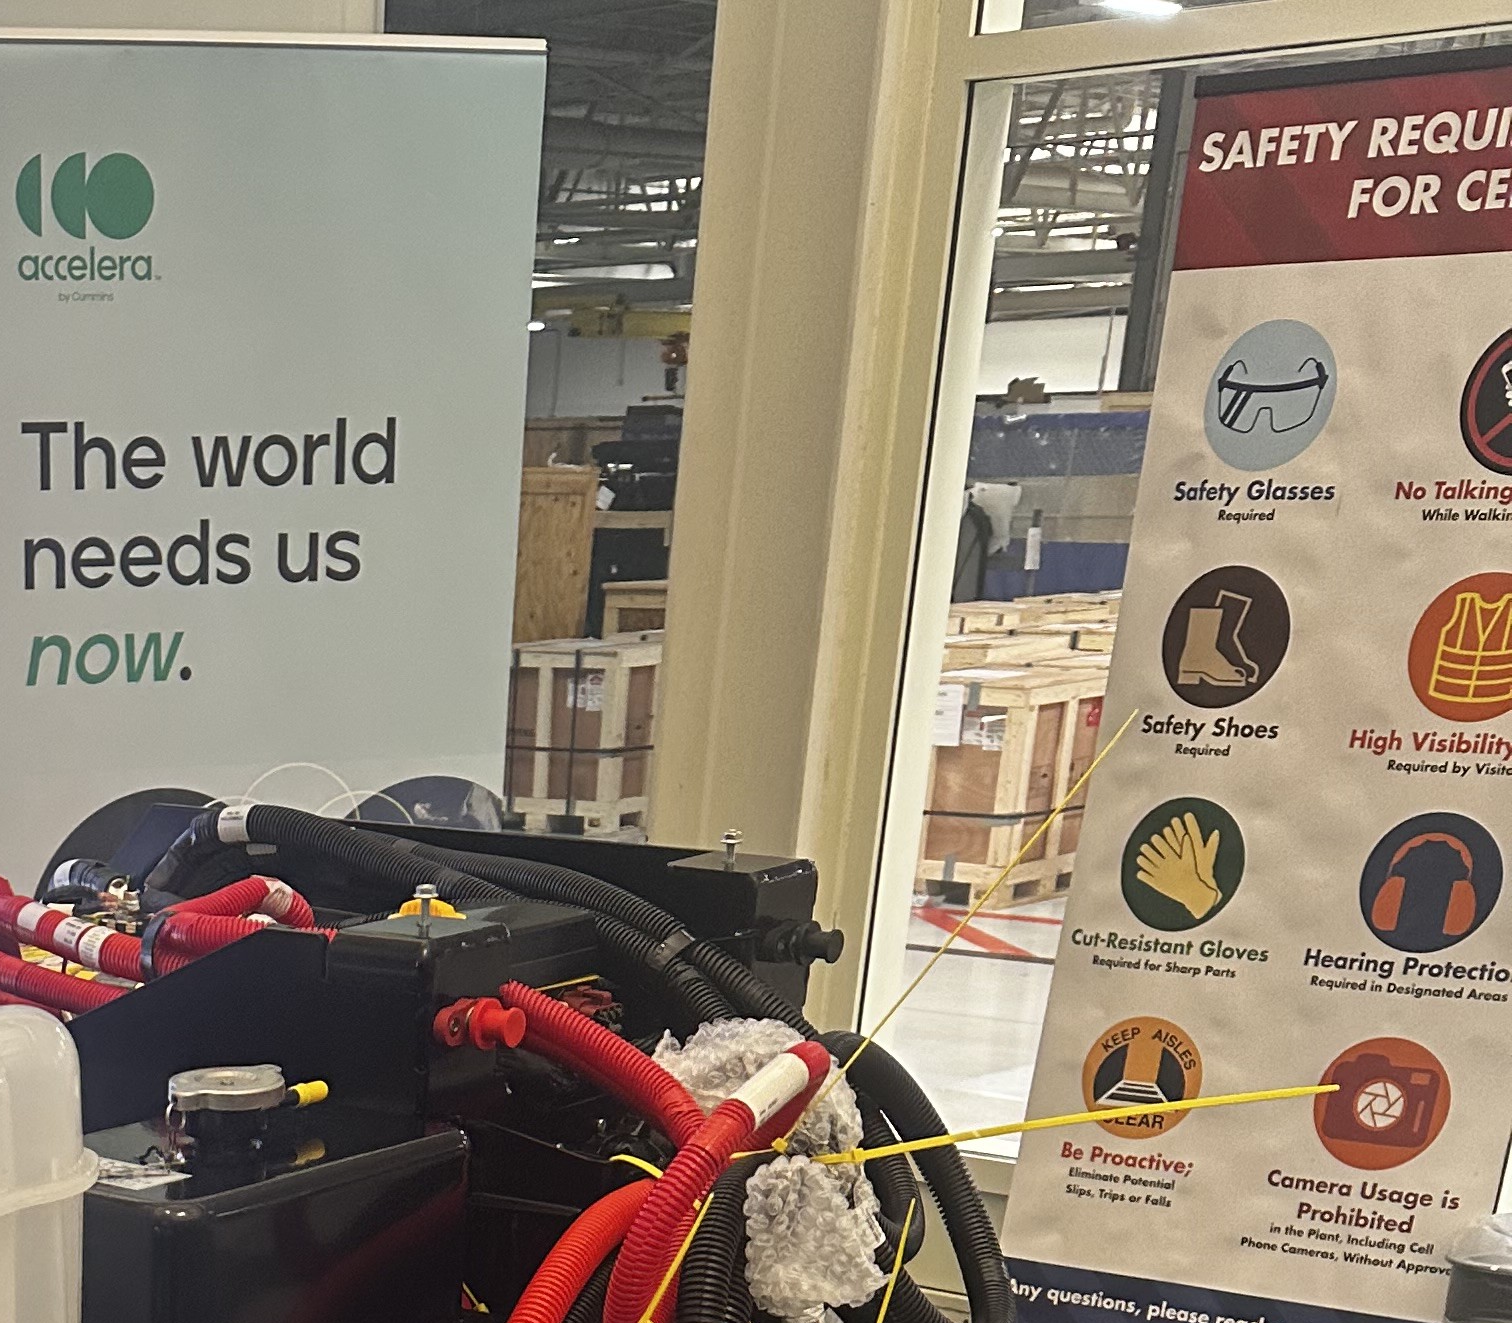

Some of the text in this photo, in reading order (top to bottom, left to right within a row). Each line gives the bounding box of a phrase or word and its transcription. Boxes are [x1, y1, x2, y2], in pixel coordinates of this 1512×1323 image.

[1198, 106, 1512, 173] SAFETY REQUI
[1347, 169, 1512, 219] FOR CE
[17, 246, 153, 282] accelera
[21, 417, 397, 491] The world
[1174, 479, 1336, 506] Safety Glasses
[1395, 479, 1512, 506] No Talking
[1217, 509, 1276, 525] Required
[1421, 508, 1460, 522] While
[24, 519, 361, 591] needs us
[26, 631, 192, 687] now.
[1141, 714, 1280, 741] Safety Shoes
[1175, 744, 1231, 759] Required
[1349, 729, 1512, 761] High Visibility
[1387, 759, 1471, 778] Required by
[1071, 928, 1269, 962] Cut-Resistant Gloves
[1092, 954, 1236, 979] Required for Sharp Parts
[1303, 948, 1512, 983] Hearing Protectio
[1310, 975, 1508, 1002] Required in Designated Areas
[1102, 1026, 1141, 1053] KEEP
[1151, 1029, 1197, 1071] AISLES
[1061, 1141, 1194, 1178] Be Proactive;
[1069, 1167, 1176, 1191] Eliminate Potential
[1267, 1169, 1460, 1210] Camera Usage is
[1065, 1183, 1172, 1208] Slips, Trips or Falls
[1297, 1202, 1415, 1234] Prohibited
[1240, 1236, 1393, 1268] Phone Cameras, Without
[1269, 1222, 1434, 1255] in the Plant, Including Cell
[1010, 1278, 1042, 1301] Any
[1047, 1287, 1141, 1316] questions,
